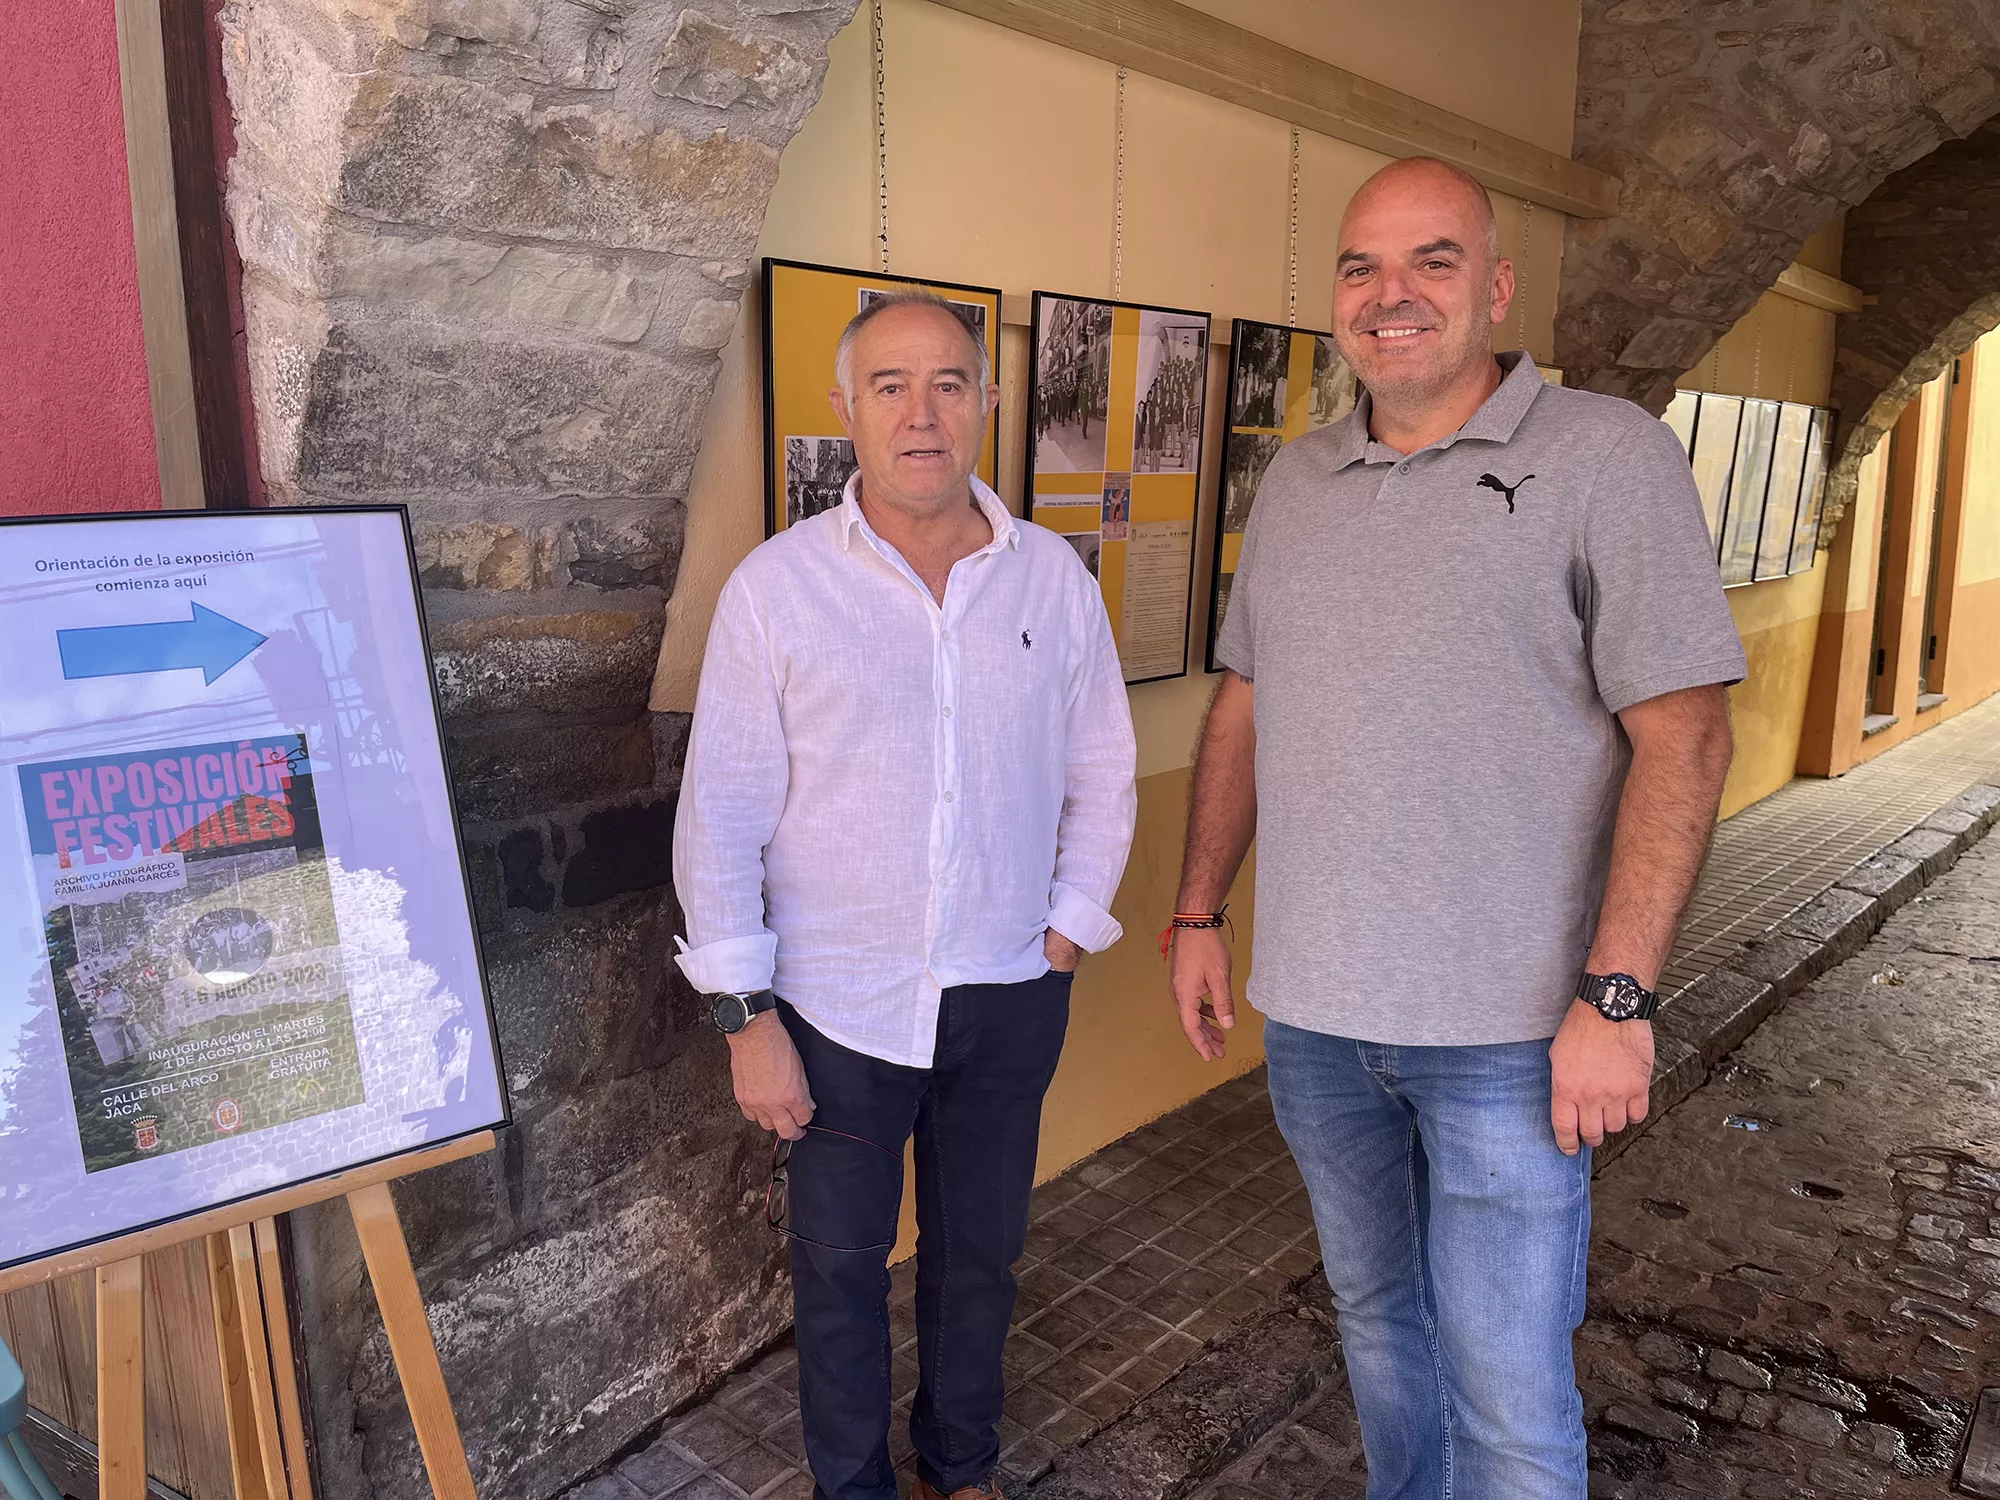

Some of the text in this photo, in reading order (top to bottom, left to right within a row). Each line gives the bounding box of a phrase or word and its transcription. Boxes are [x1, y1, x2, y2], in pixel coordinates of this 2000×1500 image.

[34, 549, 255, 572] Orientación de la exposición
[95, 574, 208, 593] comienza aquí
[40, 740, 292, 820] EXPOSICIÓN
[52, 793, 296, 869] FESTIVALES
[53, 861, 176, 888] ARCHIVO FOTOGRÁFICO
[54, 869, 180, 896] FAMILIA JUANÍN-GARCÉS
[214, 971, 278, 1002] AGOSTO
[282, 961, 327, 988] 2023
[148, 1014, 325, 1062] INAUGURACIÓN EL MARTES
[163, 1025, 327, 1070] 1 DE AGOSTO A LAS 12:00
[269, 1057, 332, 1080] GRATUITA
[270, 1046, 331, 1069] ENTRADA
[102, 1072, 219, 1107] CALLE DEL ARCO
[104, 1102, 142, 1120] JACA
